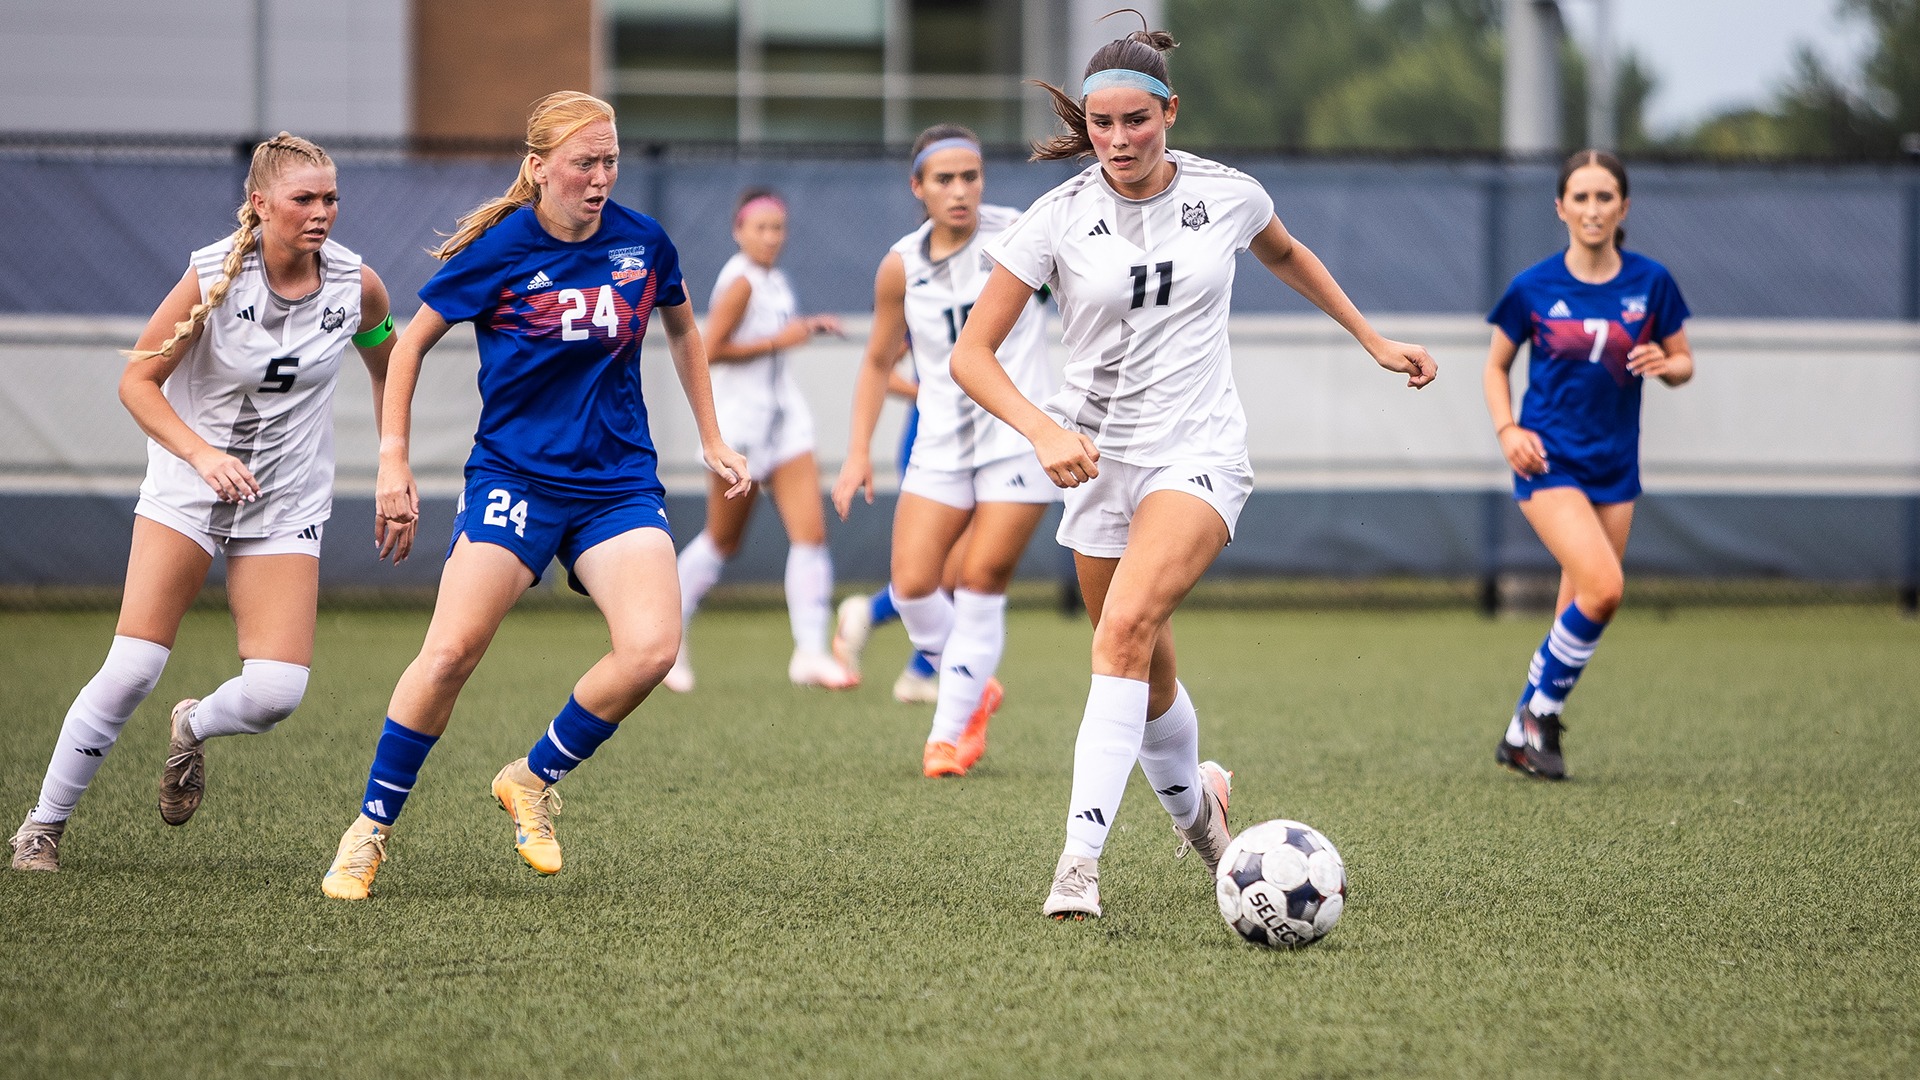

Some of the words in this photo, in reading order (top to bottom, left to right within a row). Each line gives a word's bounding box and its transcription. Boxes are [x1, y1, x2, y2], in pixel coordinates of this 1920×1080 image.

[527, 281, 553, 290] adidas
[1128, 260, 1174, 310] 11
[558, 284, 619, 341] 24
[1583, 318, 1609, 363] 7
[257, 356, 300, 393] 5
[483, 488, 528, 538] 24
[1249, 892, 1306, 942] SELEC
